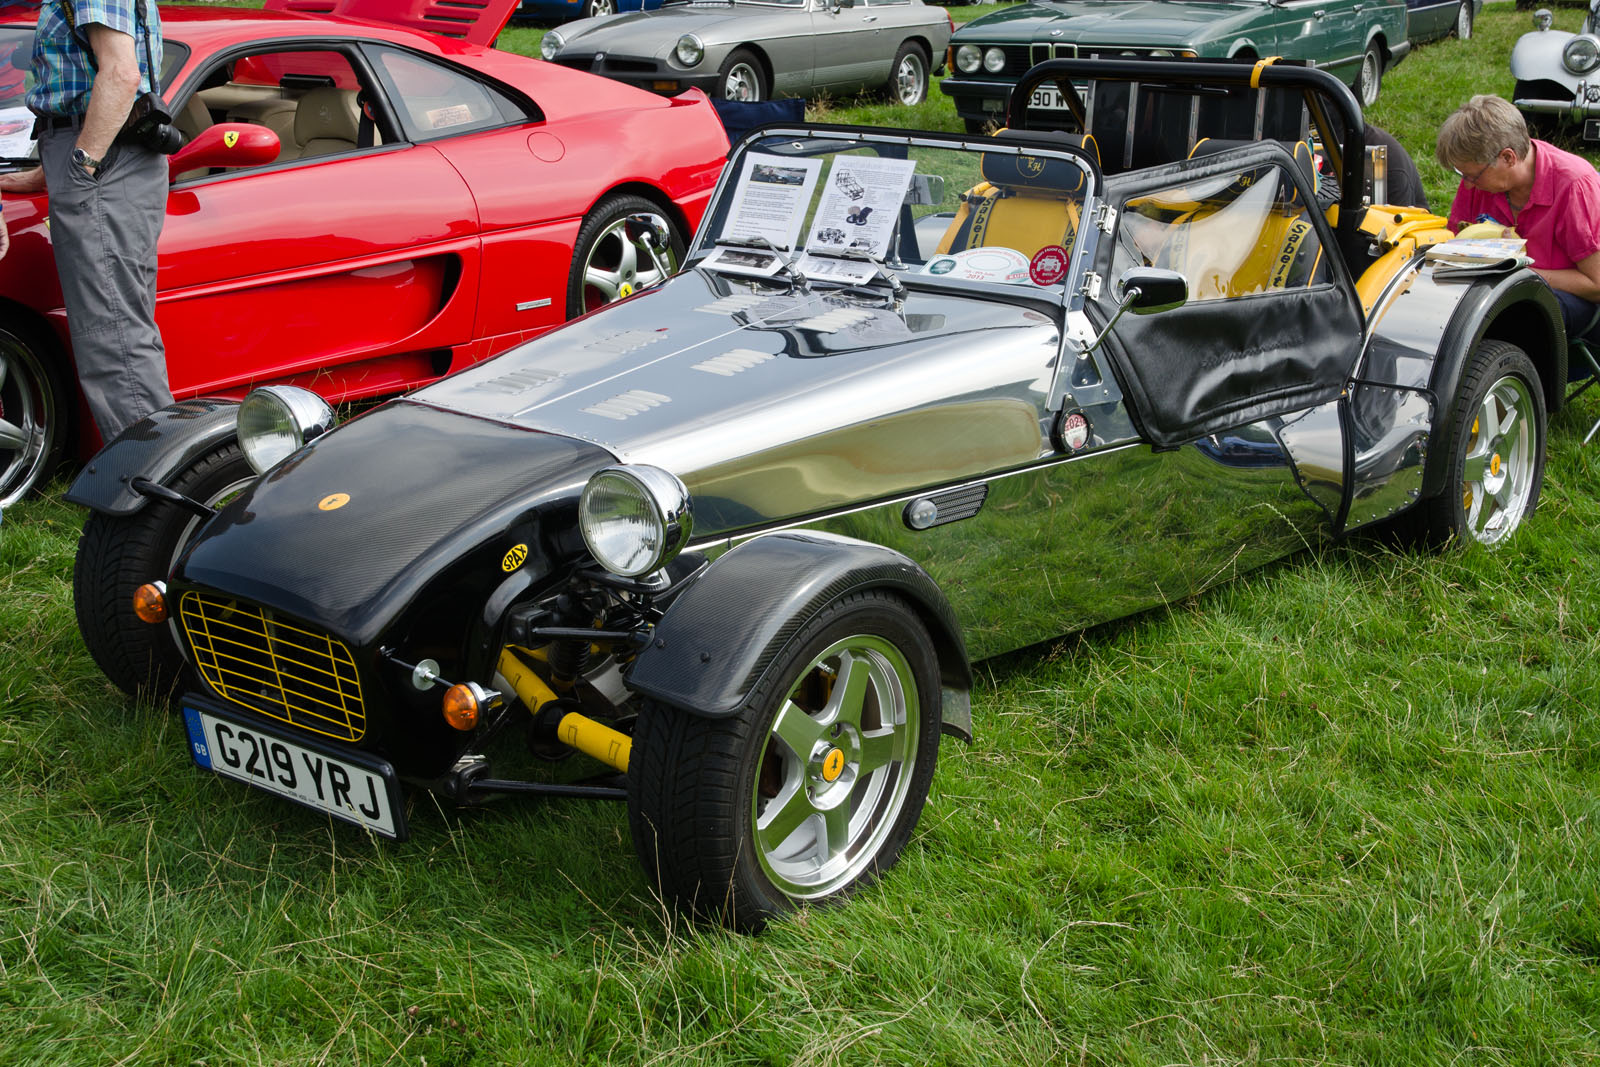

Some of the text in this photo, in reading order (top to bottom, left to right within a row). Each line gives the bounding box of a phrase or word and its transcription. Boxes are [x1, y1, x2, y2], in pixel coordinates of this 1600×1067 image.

[1272, 224, 1307, 287] Sabelt
[504, 546, 527, 570] SPAX
[194, 742, 207, 756] GB
[215, 722, 380, 820] G219 YRJ
